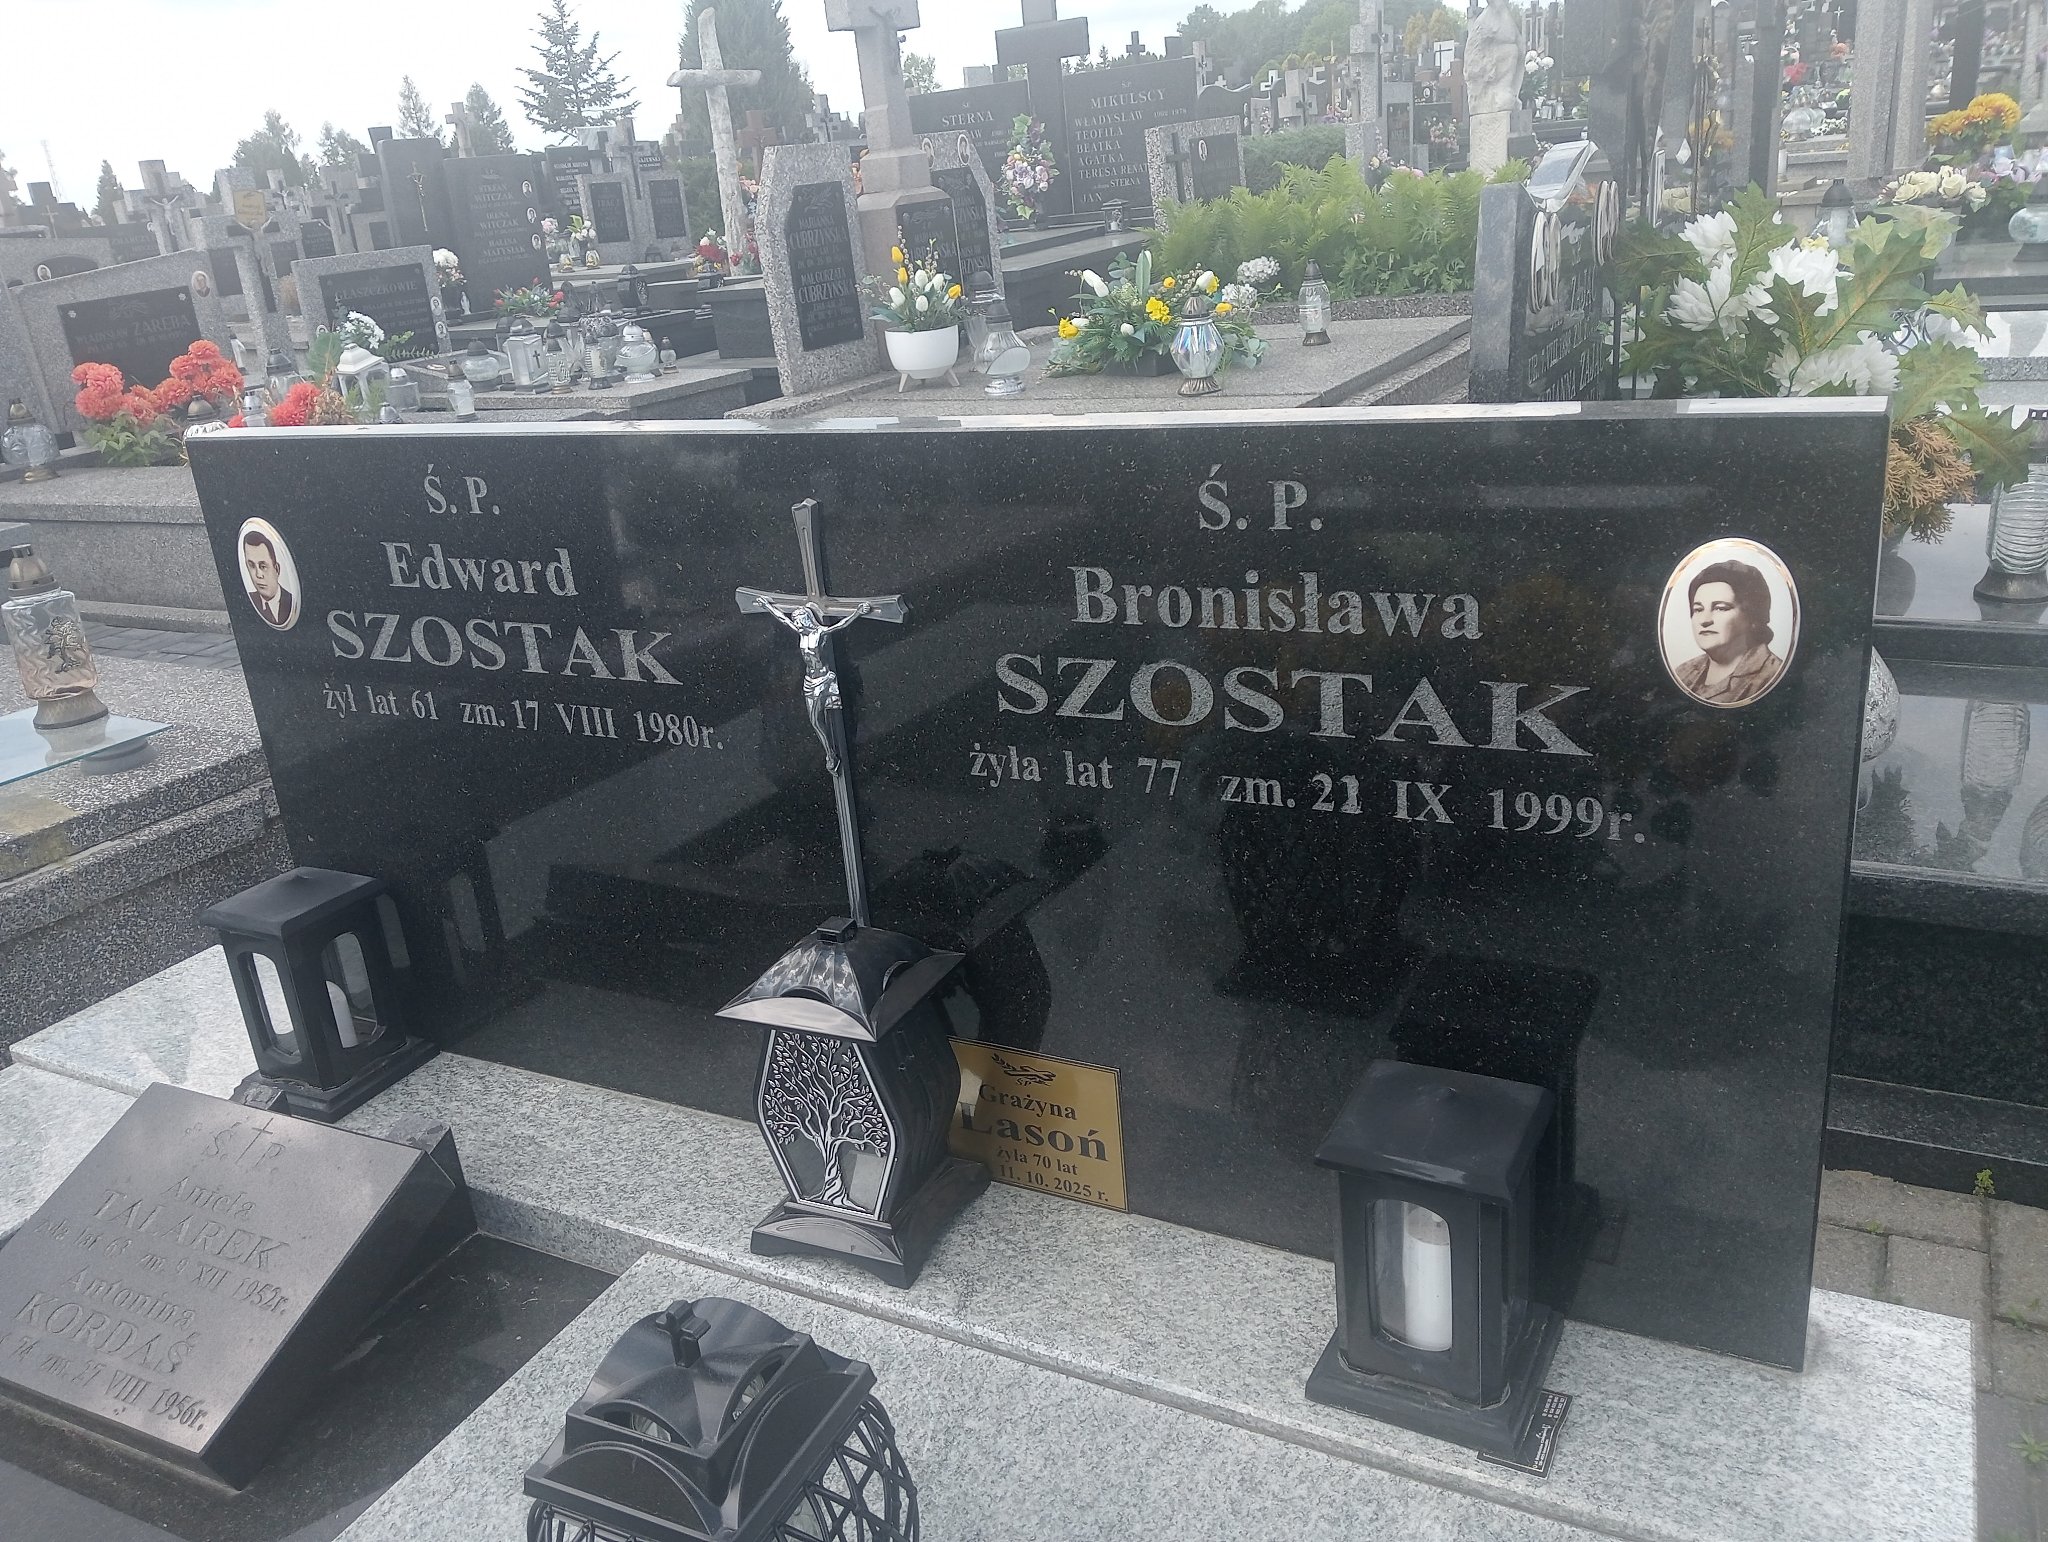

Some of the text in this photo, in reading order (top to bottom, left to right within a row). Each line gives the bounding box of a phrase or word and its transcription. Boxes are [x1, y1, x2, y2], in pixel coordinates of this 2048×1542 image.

[942, 110, 994, 127] STERNA
[1091, 88, 1166, 109] MIKULSCY
[1075, 126, 1124, 141] TEOFILA
[1076, 140, 1121, 154] BEATKA
[1079, 152, 1124, 167] AGATKA
[1079, 163, 1149, 180] TERESA RENAT
[380, 541, 579, 597] Edward
[1066, 565, 1484, 641] Bronisława
[326, 609, 684, 687] SZOSTAK
[322, 682, 358, 719] żył
[365, 685, 400, 716] lat
[411, 688, 439, 720] 61
[554, 702, 620, 739] VIII
[632, 709, 725, 750] 1980r.
[994, 652, 1595, 758] SZOSTAK
[969, 741, 1647, 845] żyła lat 77 zm. 21 IX 1999r.
[979, 1082, 1078, 1121] Grażyna
[958, 1101, 1109, 1162] Lasoń
[997, 1146, 1079, 1176] żyła 70 lat
[1026, 1170, 1049, 1188] 10.
[1053, 1177, 1092, 1198] 2025
[1097, 1189, 1109, 1202] r.
[160, 1175, 257, 1219] Aniela
[93, 1188, 290, 1273] TALAREK
[61, 1265, 195, 1330] Antonina
[13, 1289, 200, 1375] KORDAŚ
